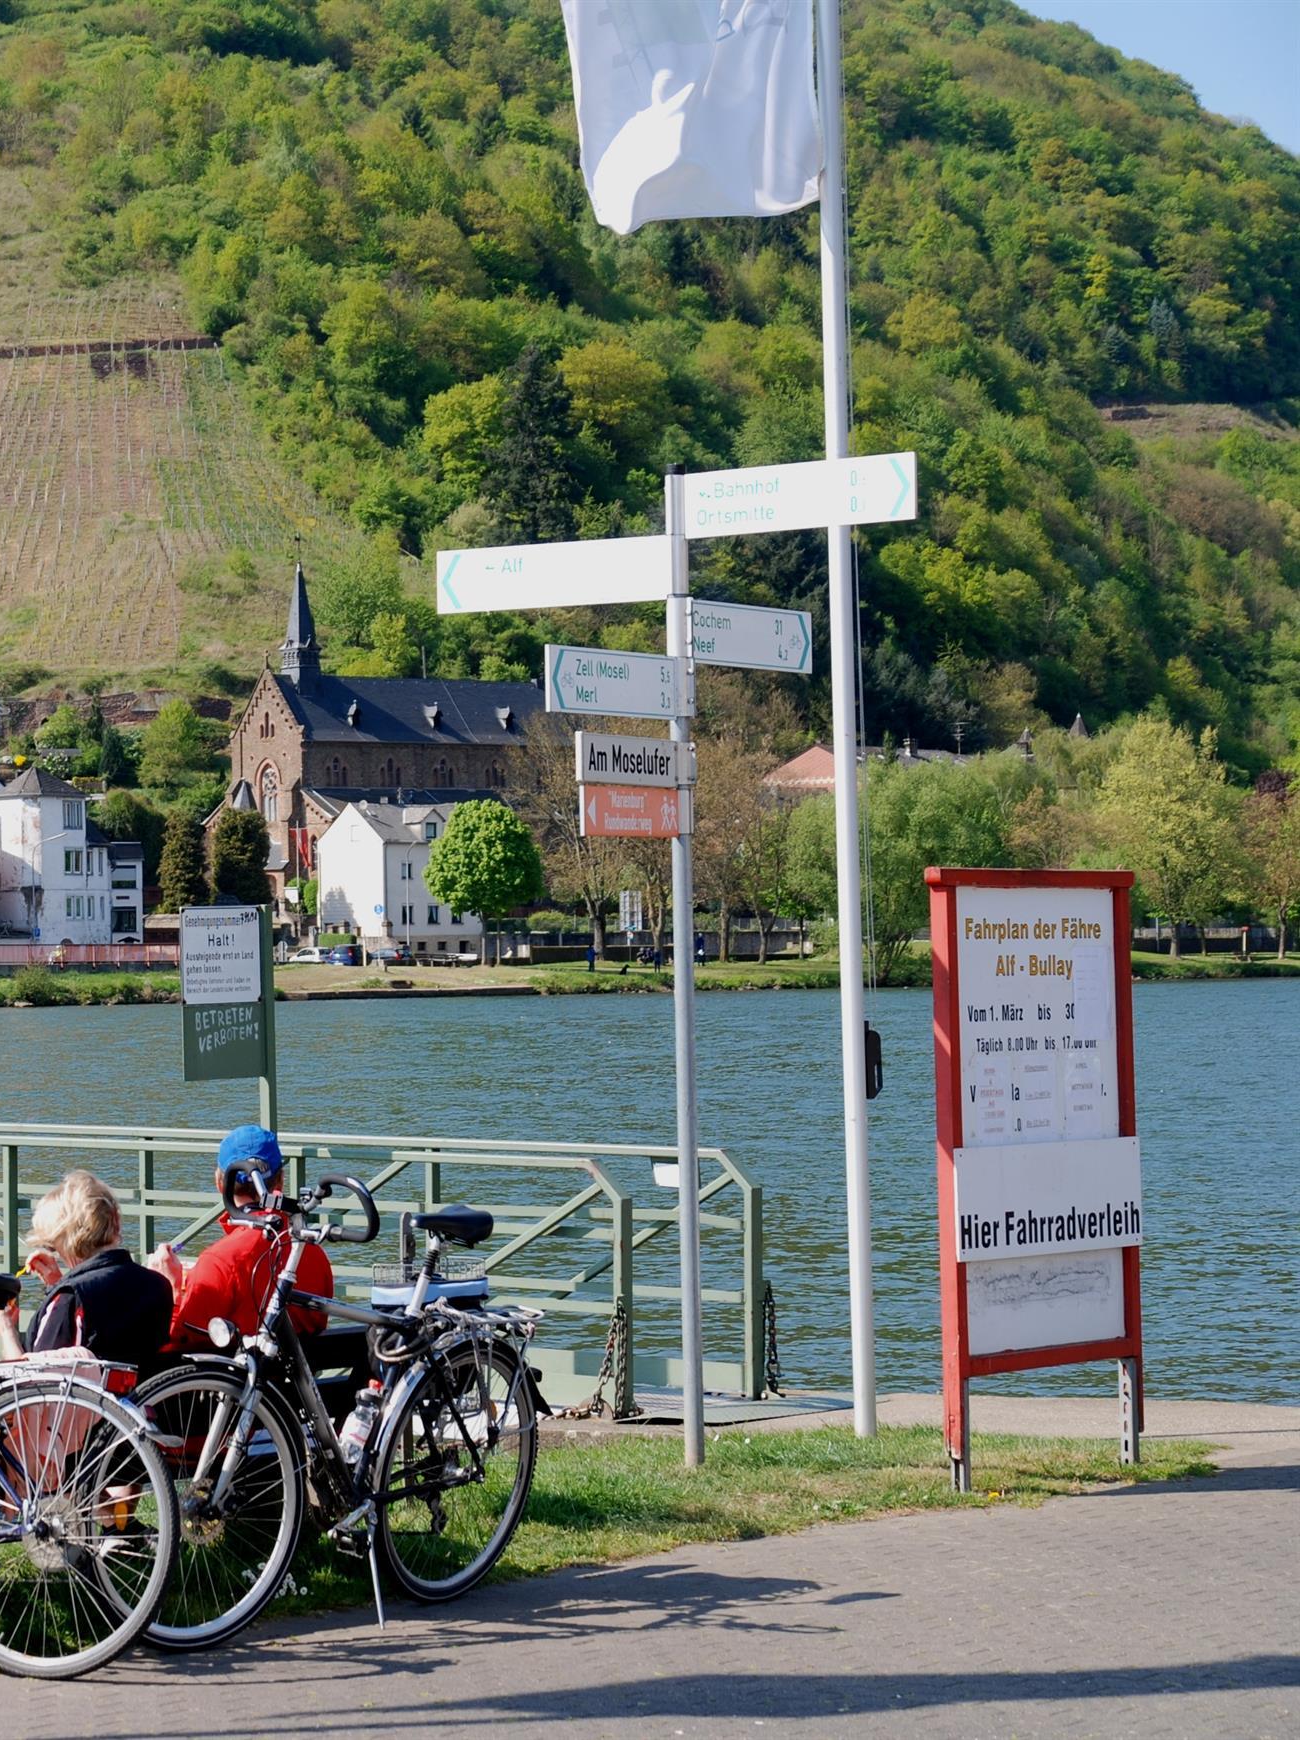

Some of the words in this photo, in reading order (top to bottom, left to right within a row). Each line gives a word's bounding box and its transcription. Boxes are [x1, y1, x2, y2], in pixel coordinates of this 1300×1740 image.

[714, 477, 780, 498] Bahnhof
[697, 506, 775, 526] Ortsmitte
[501, 557, 523, 573] Alf
[693, 610, 732, 630] Cochem
[774, 619, 783, 635] 31
[693, 636, 715, 653] Neef
[576, 659, 594, 677] Zell
[596, 660, 630, 680] (Mosel)
[576, 686, 598, 703] Merl
[589, 742, 608, 772] Am
[612, 744, 670, 776] Moselufer
[965, 918, 1029, 944] Fahrplan
[1033, 918, 1057, 939] der
[1061, 917, 1101, 939] Fähre
[241, 950, 254, 960] Land
[996, 954, 1016, 976] Alf
[1029, 954, 1073, 980] Bullay
[195, 1007, 253, 1031] BETRETEN
[967, 1005, 987, 1022] Vom
[989, 1005, 999, 1021] 1.
[1002, 1003, 1024, 1021] März
[1038, 1003, 1051, 1020] bis
[198, 1022, 259, 1053] VERBOTEN!
[976, 1038, 1003, 1055] Täglich
[1007, 1037, 1024, 1051] 8.00
[1025, 1037, 1038, 1050] Uhr
[1044, 1036, 1056, 1050] bis
[960, 1214, 1000, 1249] Hier
[1005, 1201, 1140, 1246] Fahrradverleih
